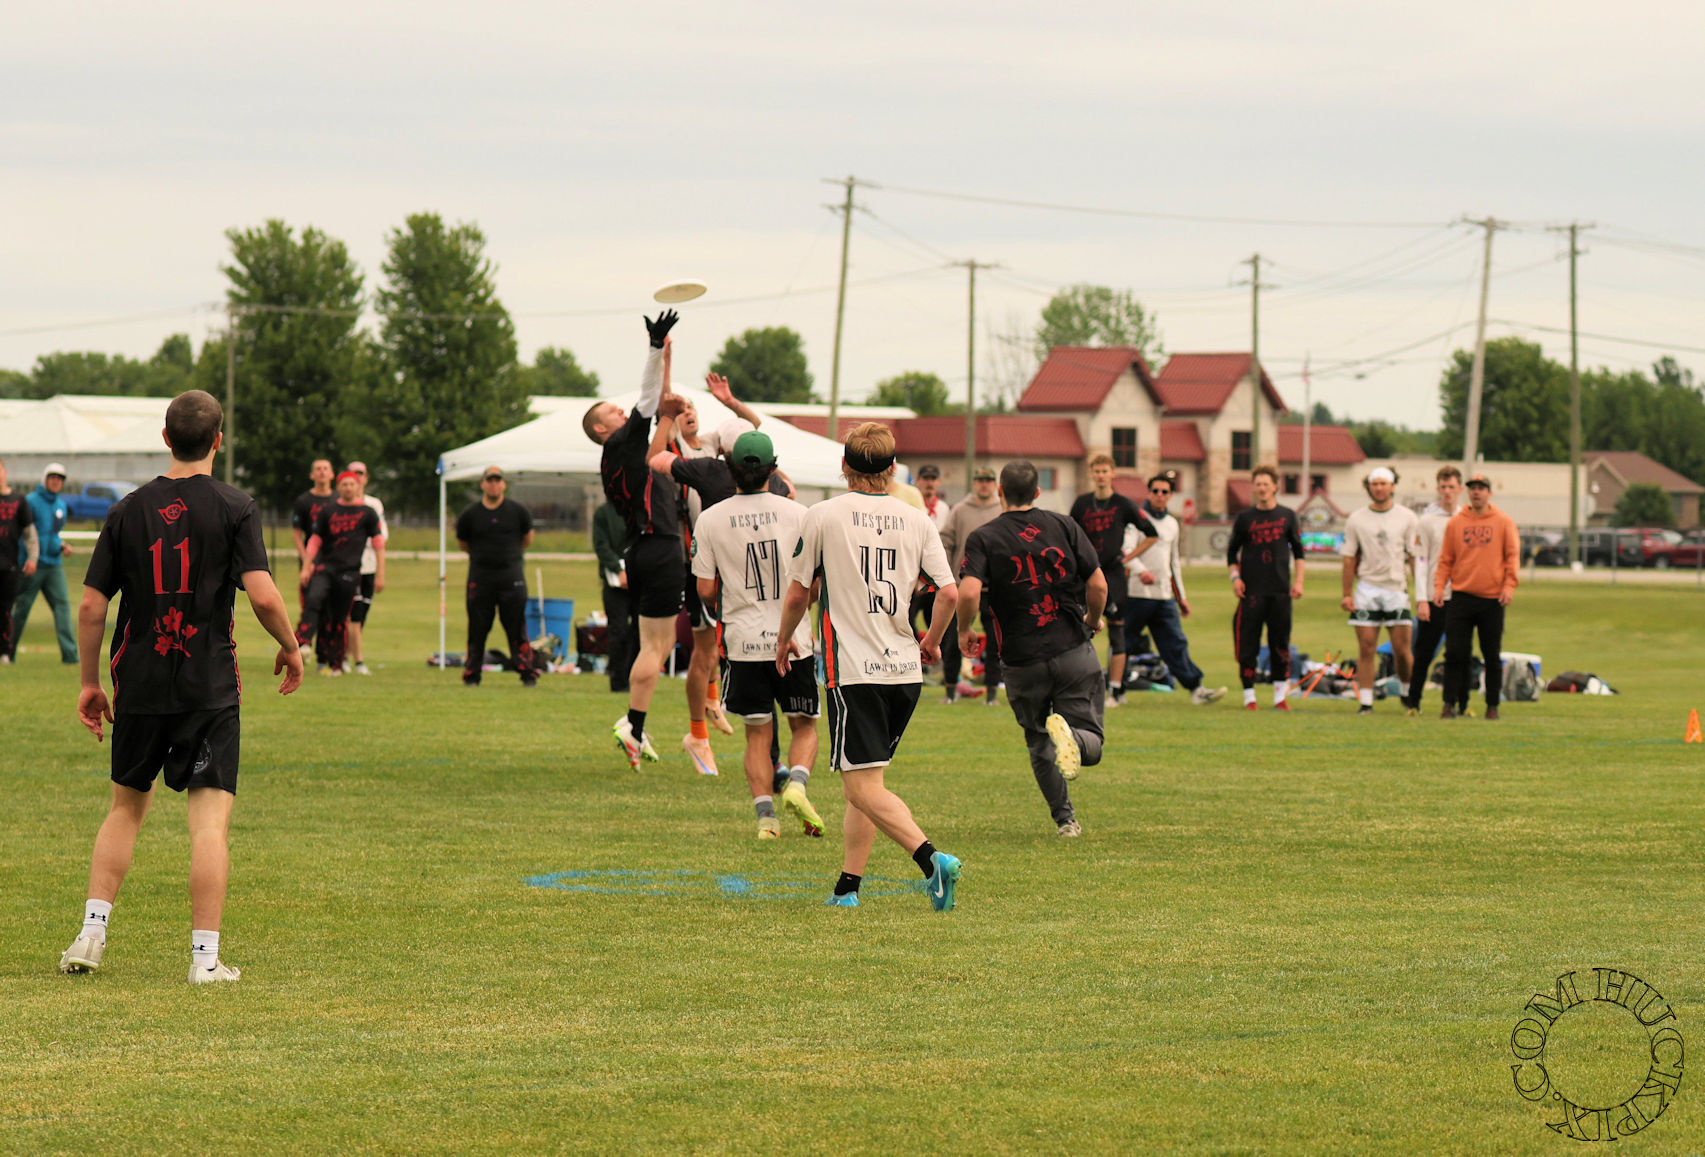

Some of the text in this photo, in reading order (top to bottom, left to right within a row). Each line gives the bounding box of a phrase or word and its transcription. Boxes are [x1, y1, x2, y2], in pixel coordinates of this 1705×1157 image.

[729, 511, 778, 529] WESTERN
[852, 511, 905, 531] WESTERN
[148, 537, 194, 595] 11
[745, 539, 780, 602] 47
[859, 545, 897, 617] 15
[1010, 546, 1067, 591] 43
[742, 640, 761, 655] LAWN
